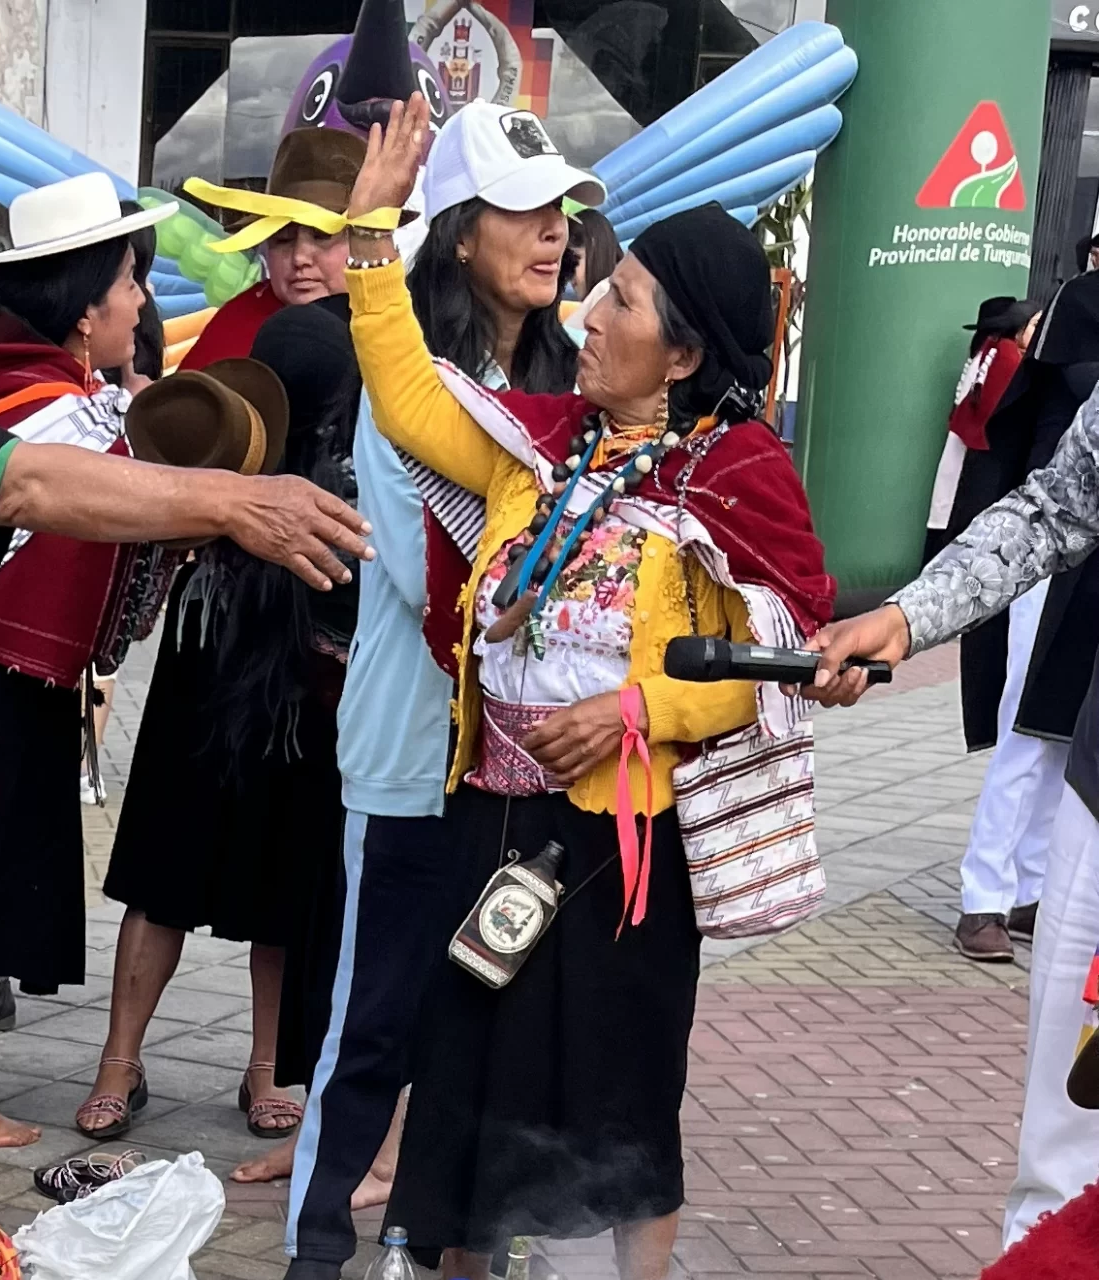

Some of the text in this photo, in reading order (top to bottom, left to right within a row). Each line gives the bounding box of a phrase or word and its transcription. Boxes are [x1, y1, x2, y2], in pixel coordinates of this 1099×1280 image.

[1068, 5, 1099, 32] C
[892, 221, 983, 244] Honorable
[868, 242, 957, 267] Provincial
[959, 242, 979, 262] de
